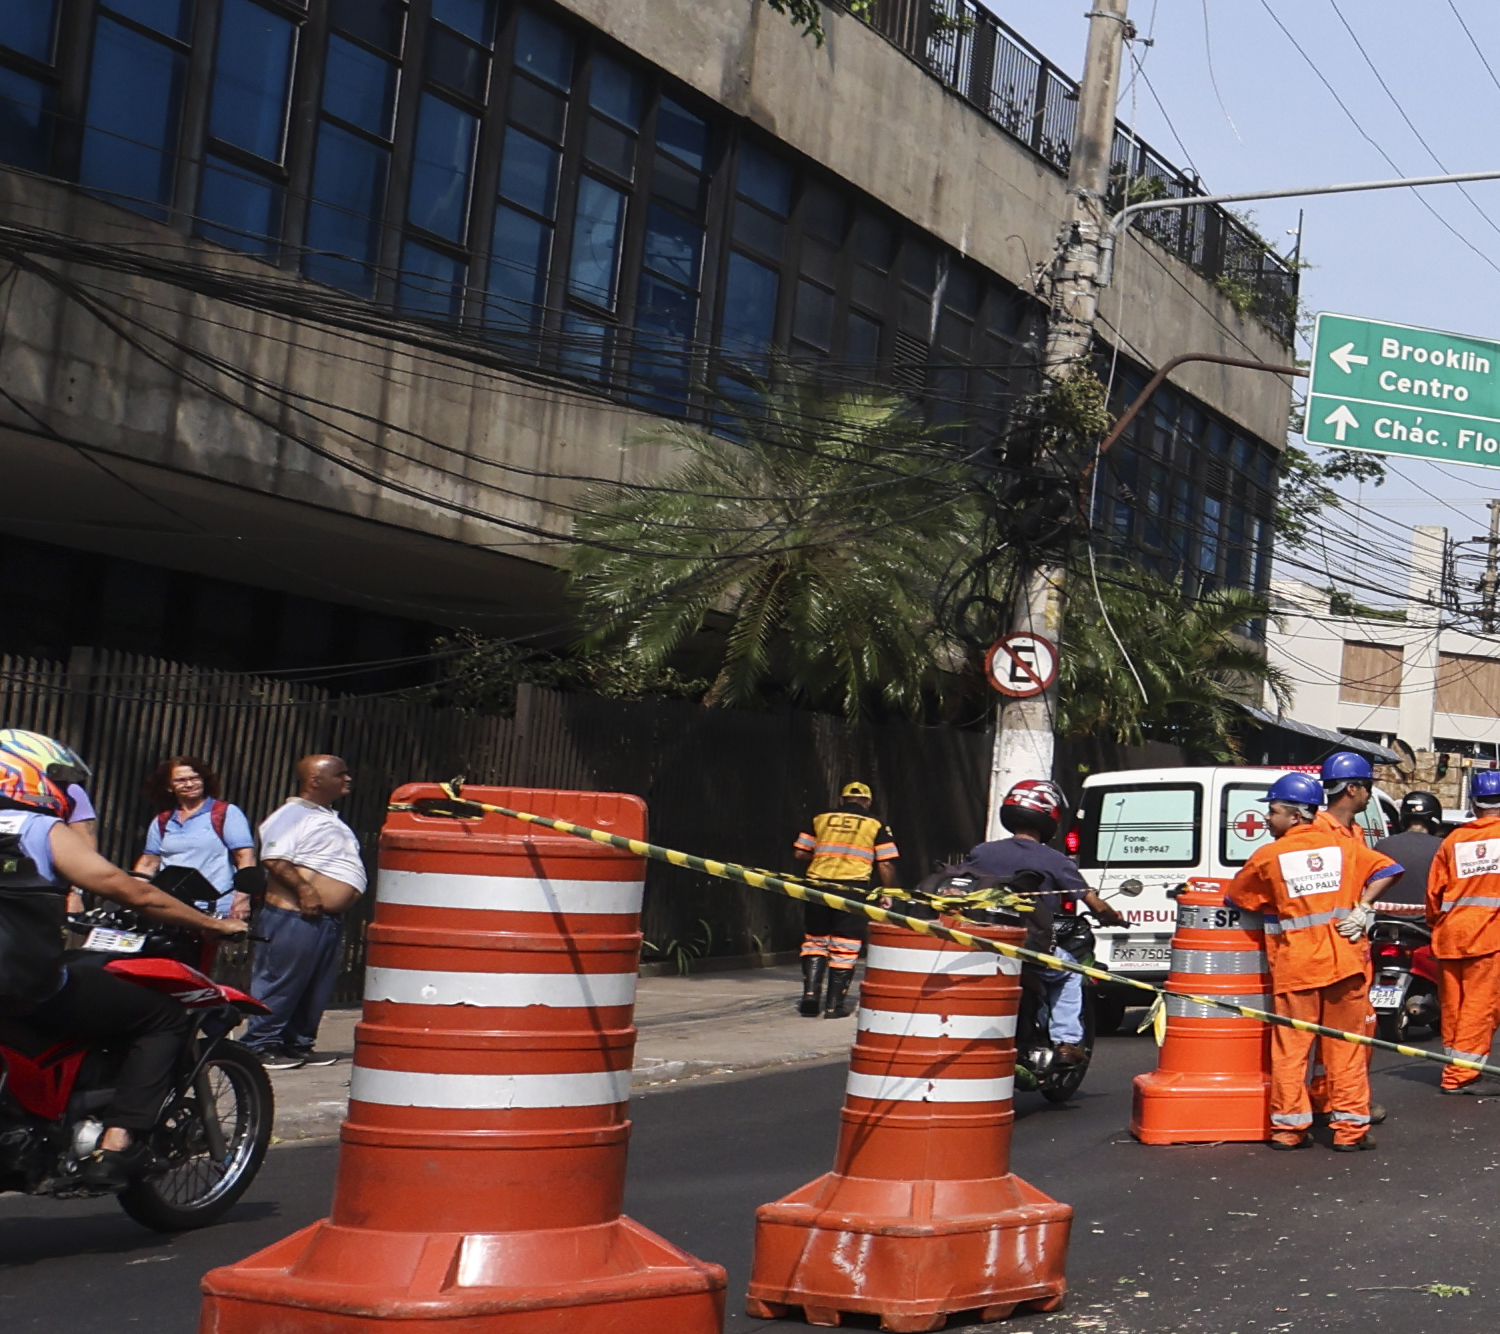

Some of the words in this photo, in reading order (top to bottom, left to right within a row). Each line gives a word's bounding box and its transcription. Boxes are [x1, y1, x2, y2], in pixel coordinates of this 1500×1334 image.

[1382, 338, 1490, 373] Brooklin
[1379, 371, 1469, 402] Centro
[1373, 416, 1448, 448] Chác.
[1009, 645, 1035, 683] E
[827, 814, 866, 830] CET
[1123, 834, 1150, 843] Fone:
[1123, 845, 1170, 854] 5189-9947
[1215, 909, 1241, 928] SP
